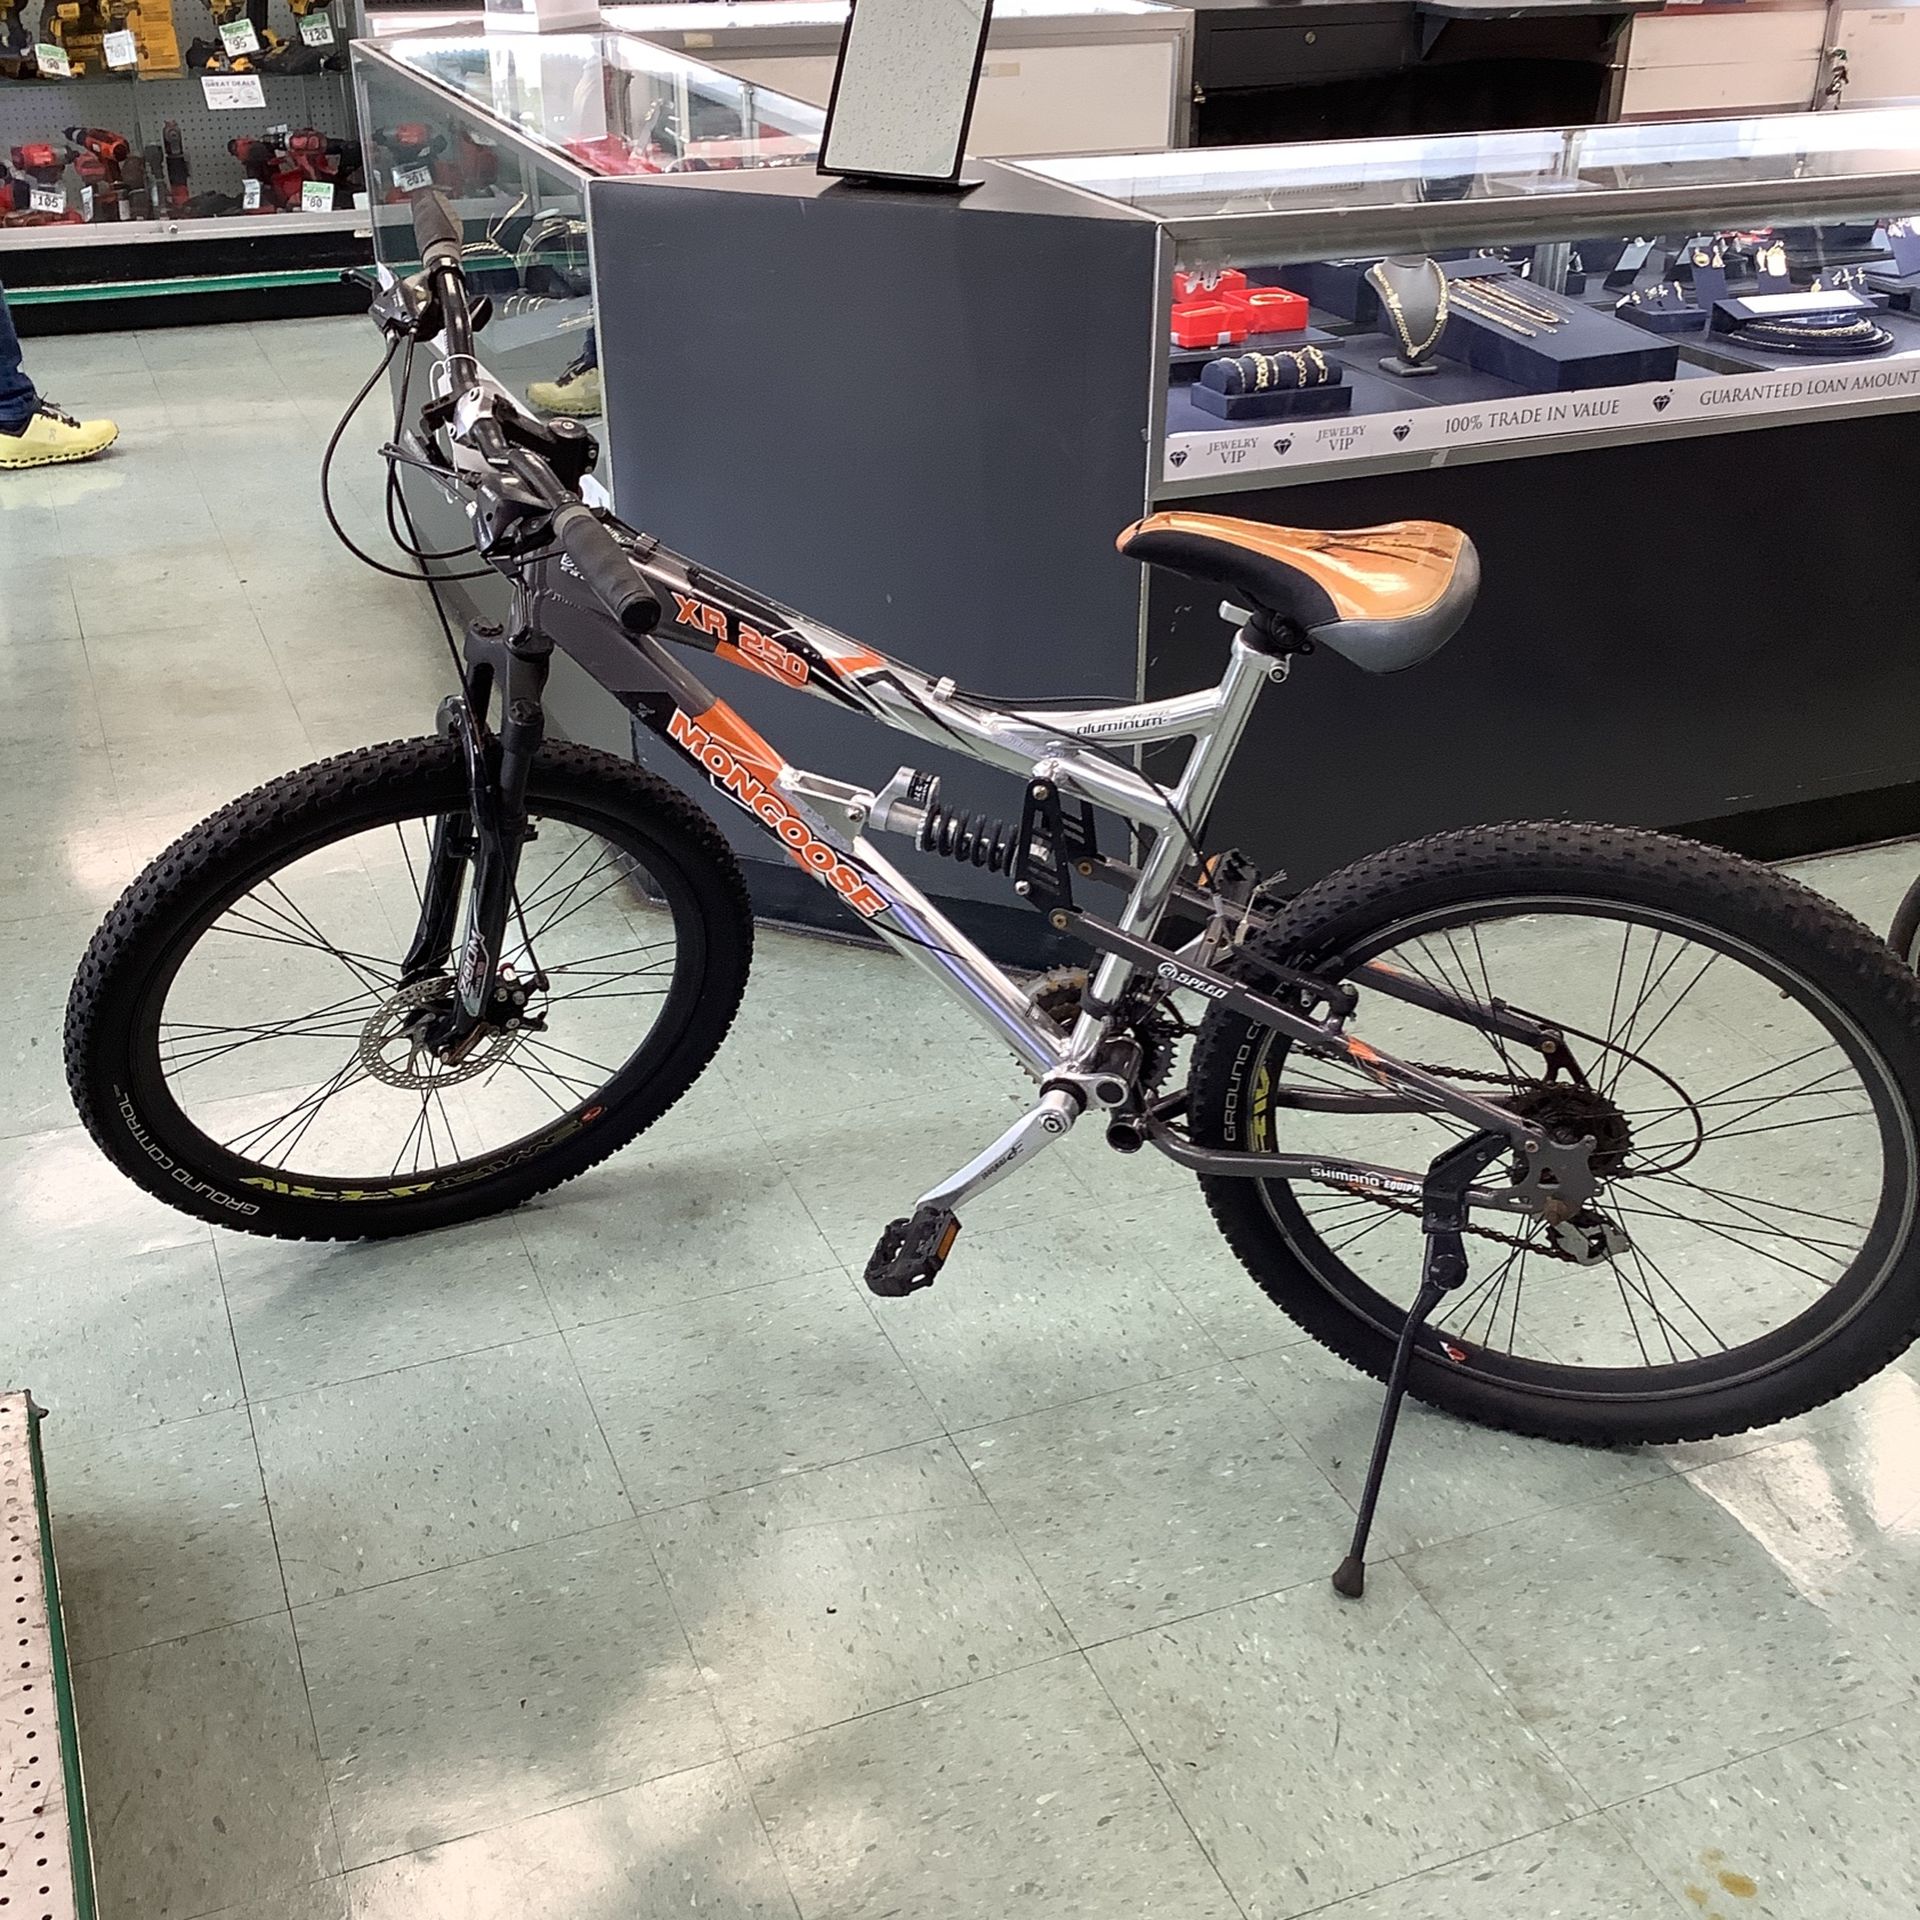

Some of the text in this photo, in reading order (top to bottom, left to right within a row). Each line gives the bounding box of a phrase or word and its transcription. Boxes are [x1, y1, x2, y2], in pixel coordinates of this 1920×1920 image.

[1699, 369, 1920, 406] GUARANTEED LOAN AMOUNT
[1444, 399, 1620, 434] 100% TRADE IN VALUE
[1206, 437, 1259, 456] JEWELRY
[1316, 425, 1368, 443] JEWELRY
[1328, 438, 1354, 451] VIP
[1220, 450, 1247, 464] VIP
[671, 591, 809, 682] XR 250
[666, 707, 890, 918] MONGOOSE
[1176, 973, 1229, 999] SPEED
[1223, 1044, 1251, 1141] GROUND
[118, 1092, 260, 1216] GROUND CONTROL
[1310, 1167, 1423, 1195] SHIMANO EQUIPP
